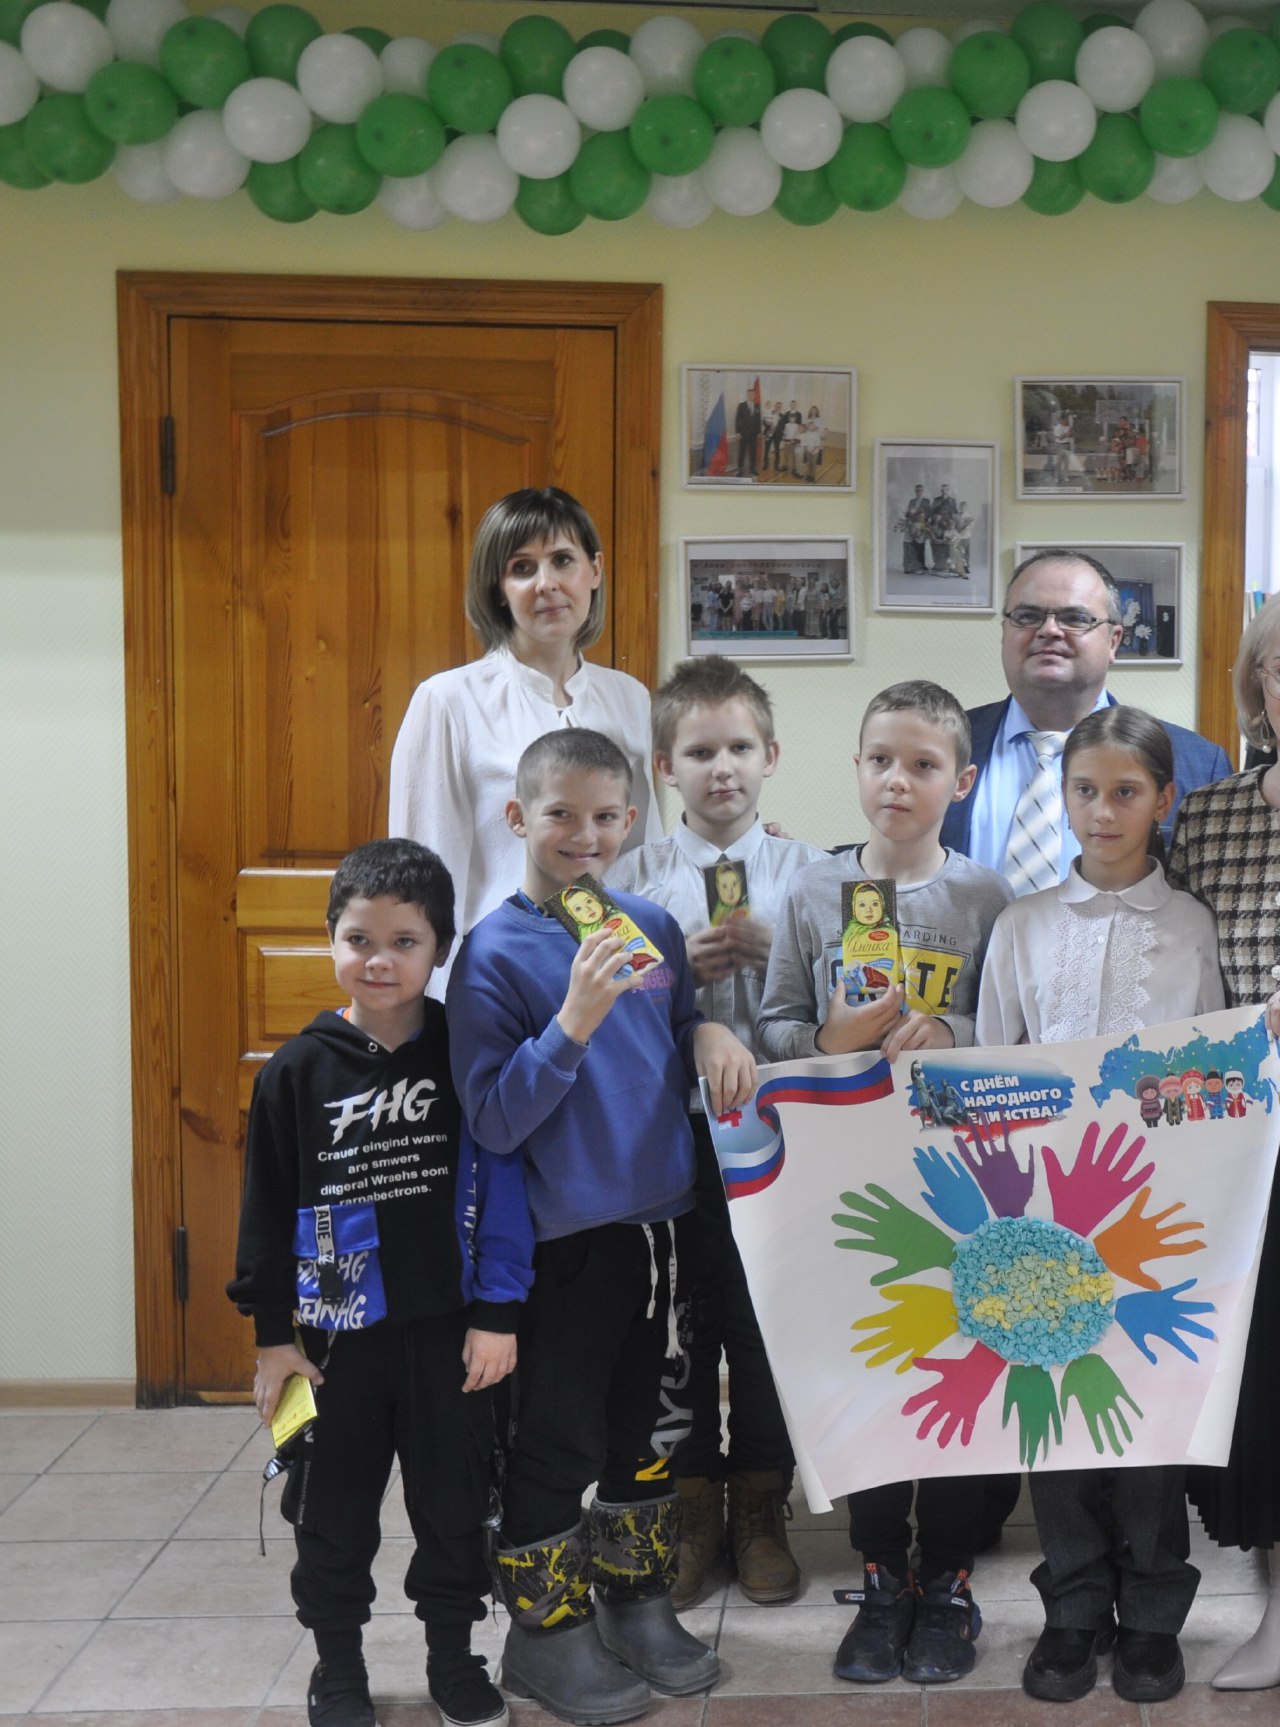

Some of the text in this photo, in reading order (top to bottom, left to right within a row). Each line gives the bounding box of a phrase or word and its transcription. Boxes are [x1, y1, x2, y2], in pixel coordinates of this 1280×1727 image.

[960, 1075, 1020, 1093] С ДНЁМ
[964, 1087, 1062, 1108] НАРОДНОГО
[323, 1077, 440, 1146] FHG
[412, 1133, 448, 1145] waren
[348, 1152, 421, 1175] are smwers
